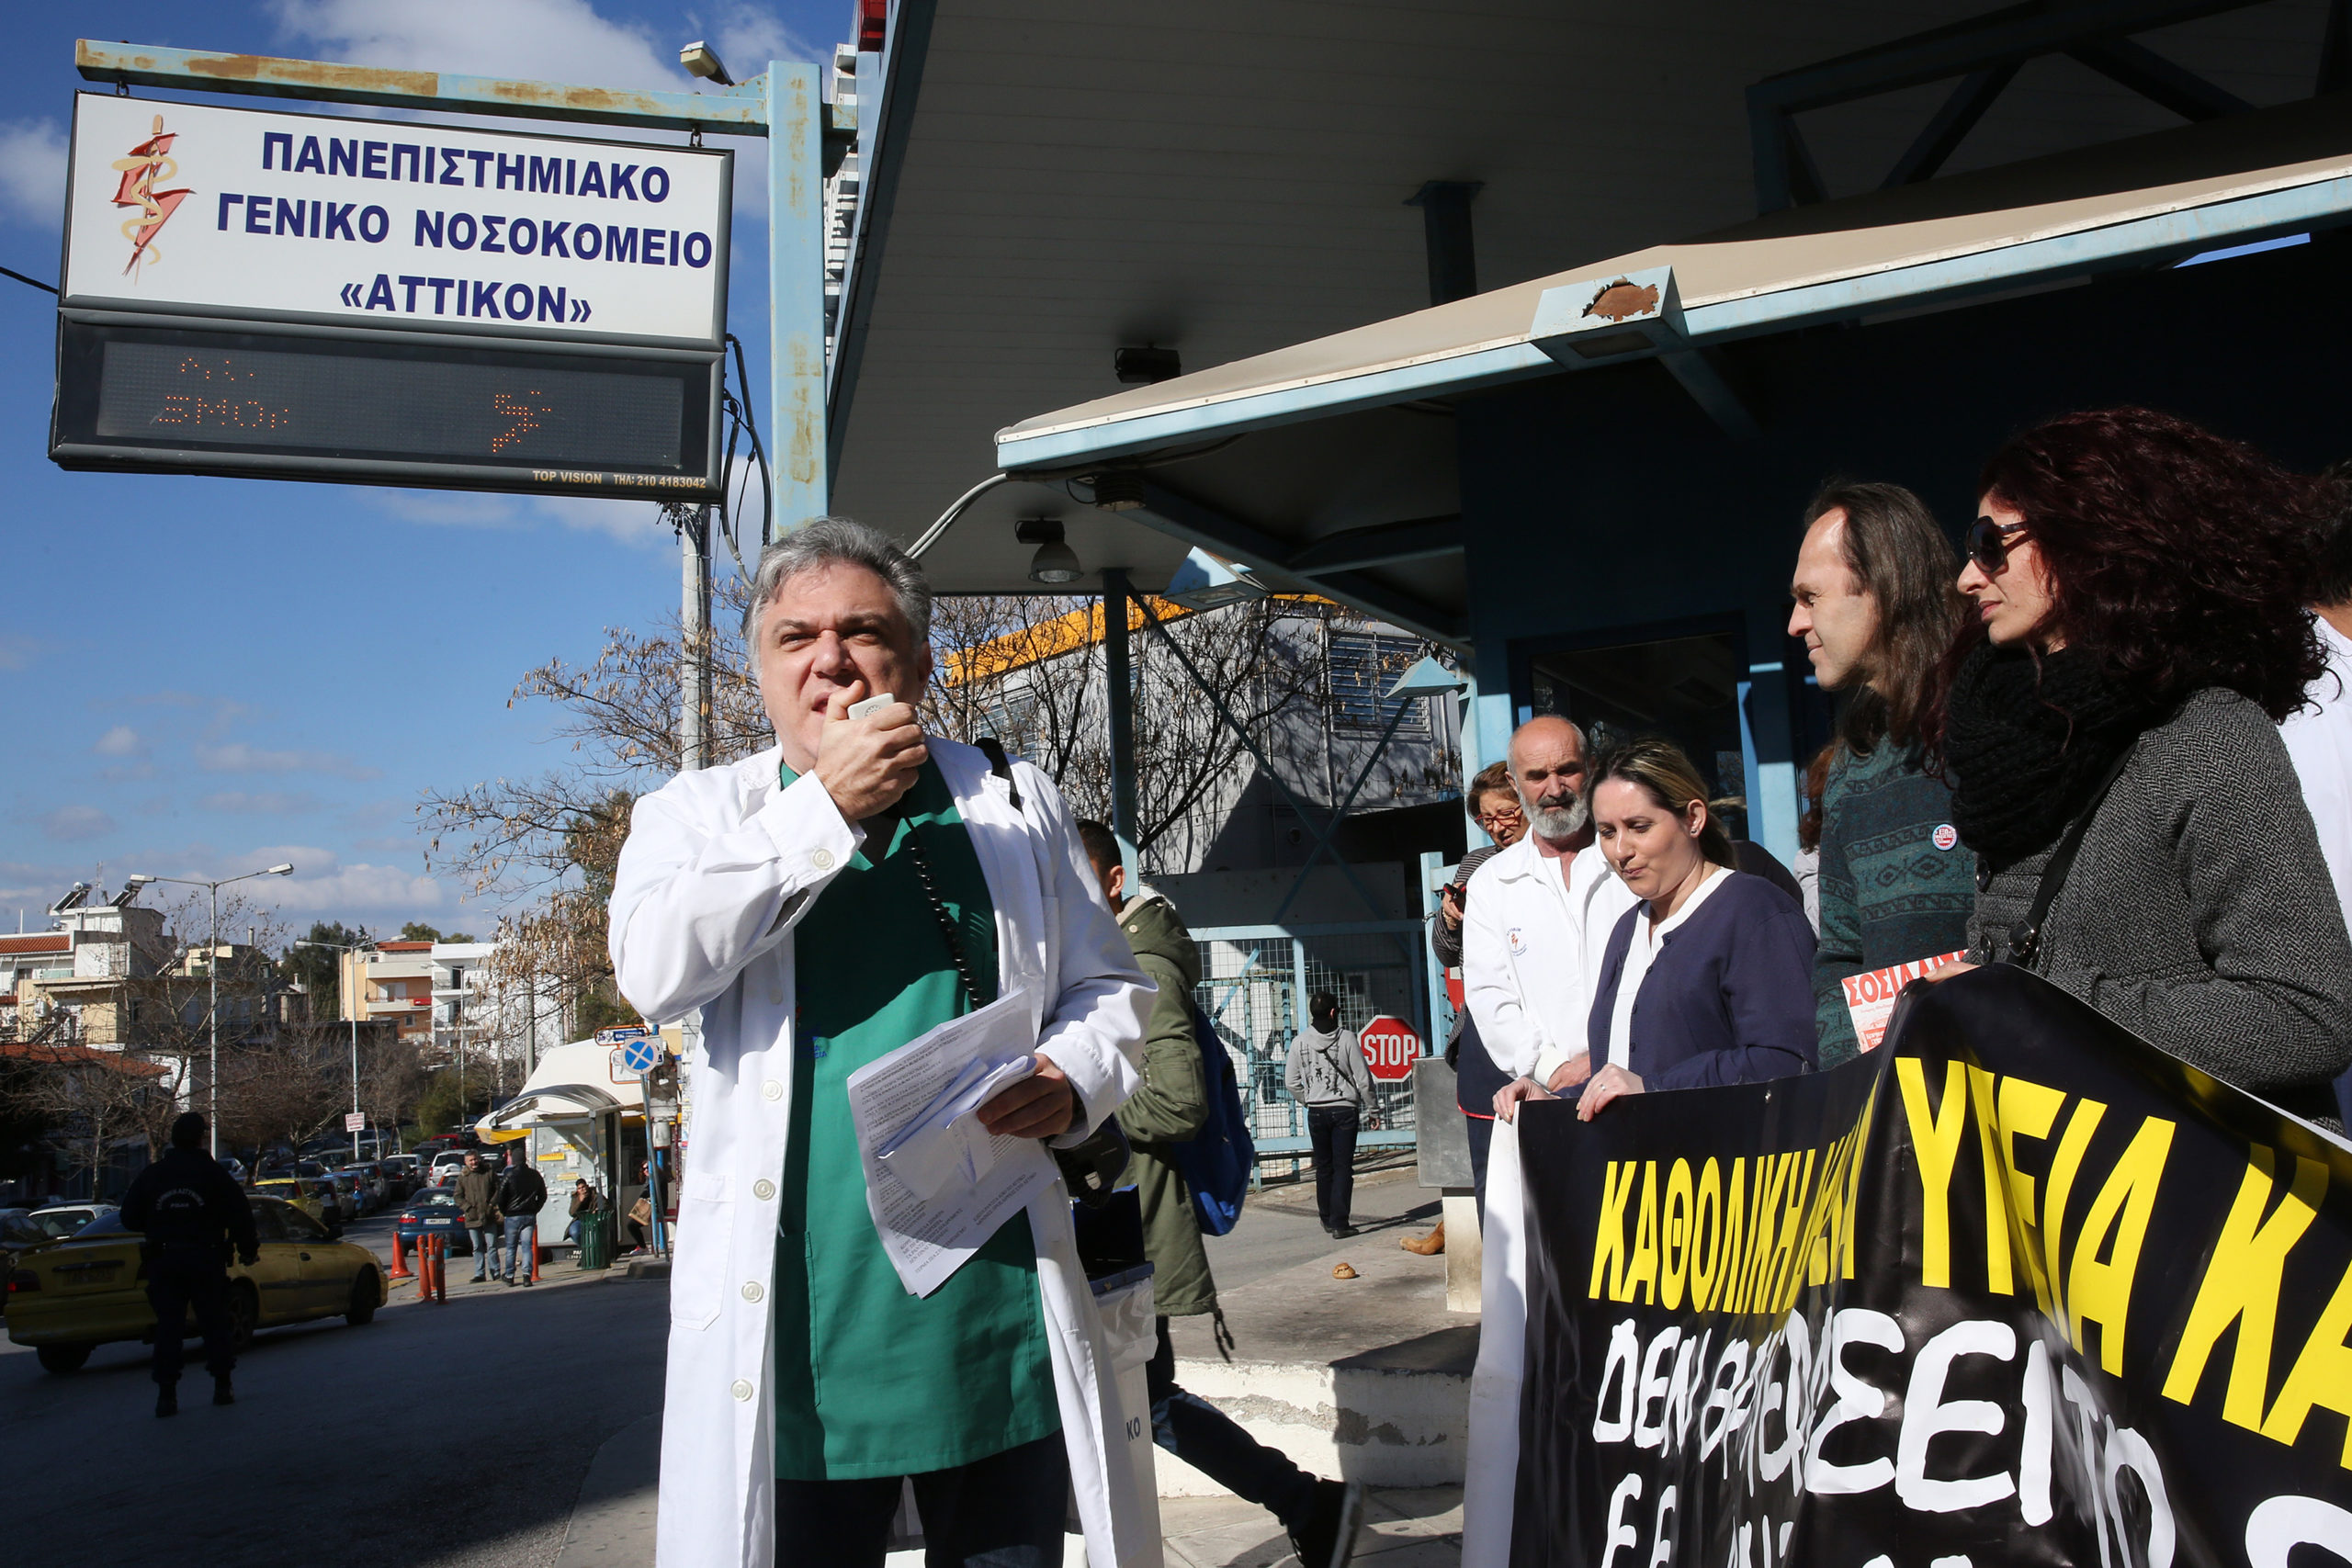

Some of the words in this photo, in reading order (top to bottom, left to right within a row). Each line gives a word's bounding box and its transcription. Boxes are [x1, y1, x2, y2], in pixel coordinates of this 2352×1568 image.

[262, 131, 671, 204] ΠΑΝΕΠΙΣΤΗΜΙΑΚΟ
[218, 193, 390, 244] ΓΕΝΙΚΟ
[414, 209, 714, 269] ΝΟΣΟΚΟΜΕΙΟ
[340, 273, 593, 324] «ΑΤΤΙΚΟΝ»
[533, 469, 557, 482] TOP
[560, 471, 602, 485] VISION
[637, 476, 656, 487] 210
[659, 476, 707, 489] 4183042
[1364, 1033, 1417, 1066] STOP
[1589, 1148, 1816, 1314] ΚΑΘΟΛΙΚΗ
[1895, 1056, 2177, 1378] ΥΓΕΙΑ
[1592, 1317, 1712, 1459] ΔΕΝ
